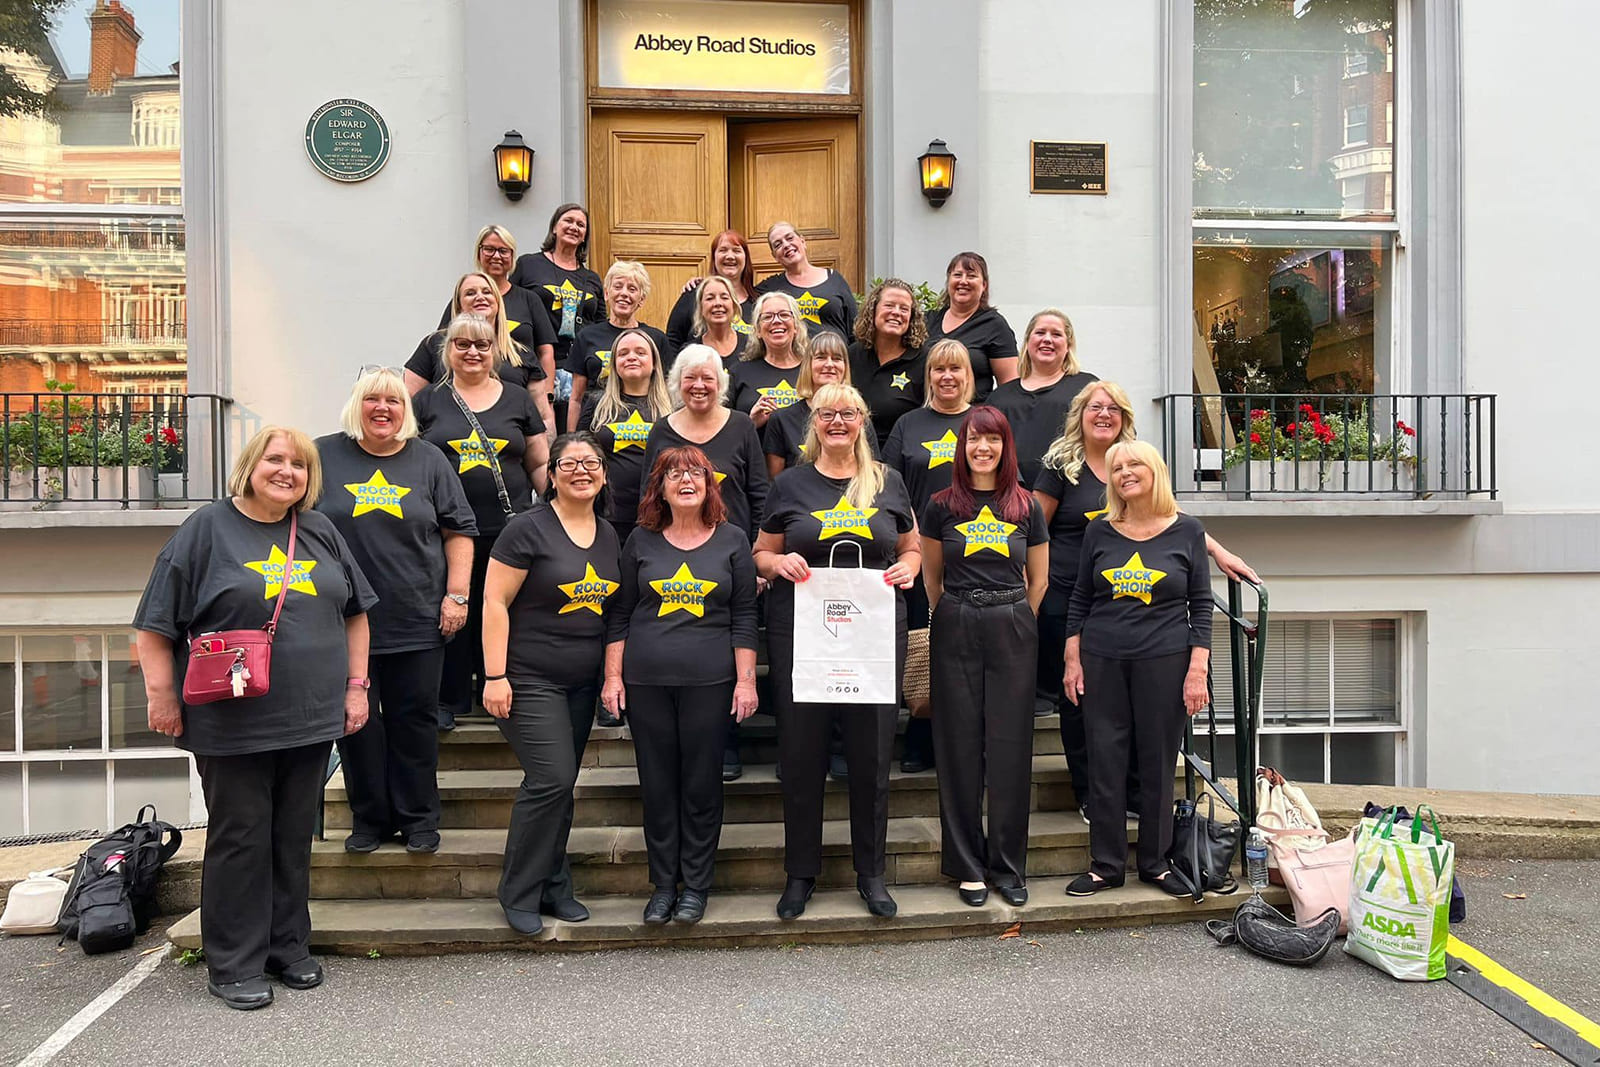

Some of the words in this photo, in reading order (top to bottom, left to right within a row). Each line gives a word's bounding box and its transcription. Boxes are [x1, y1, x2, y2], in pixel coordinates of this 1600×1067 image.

[634, 34, 693, 55] Abbey
[697, 35, 745, 53] Road
[749, 37, 816, 56] Studios
[340, 109, 354, 117] SIR
[328, 120, 367, 128] EDWARD
[332, 131, 363, 139] ELGAR
[357, 485, 398, 496] ROCK
[355, 495, 400, 505] CHOIR
[824, 510, 865, 519] ROCK
[821, 518, 869, 528] CHOIR
[967, 522, 1005, 533] ROCK
[965, 534, 1008, 544] CHOIR
[1112, 570, 1152, 581] ROCK
[573, 582, 608, 594] ROCK
[661, 581, 704, 592] ROCK
[1112, 582, 1152, 593] CHOIR
[661, 594, 705, 605] CHOIR
[827, 603, 851, 611] Abbey
[1362, 911, 1417, 940] ASDA
